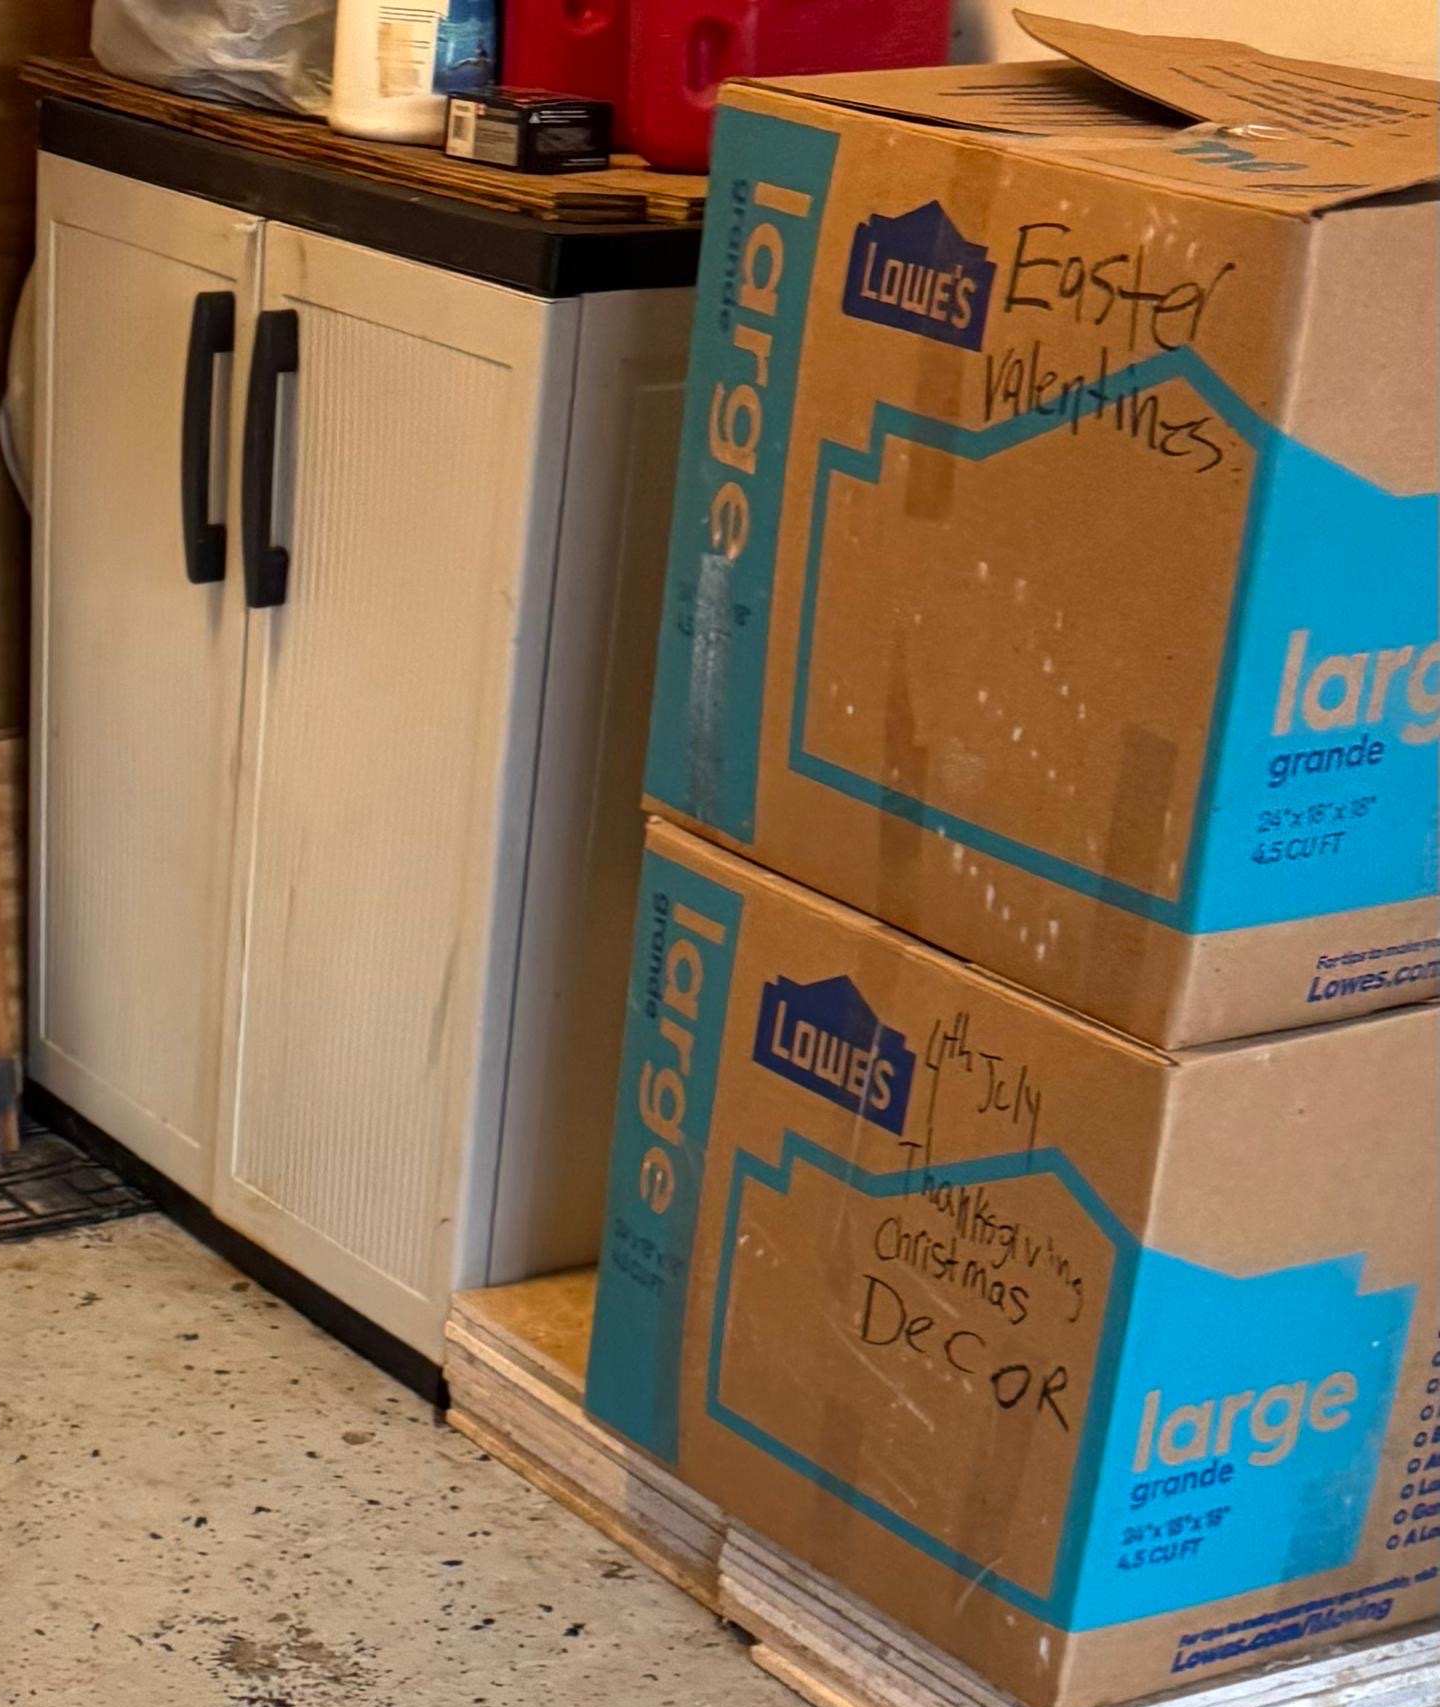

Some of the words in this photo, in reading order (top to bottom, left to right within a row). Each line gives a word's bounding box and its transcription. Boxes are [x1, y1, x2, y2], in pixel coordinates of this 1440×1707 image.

[860, 242, 977, 330] LOWE'S
[1004, 222, 1236, 352] Easter
[708, 181, 813, 561] large
[1268, 734, 1385, 788] grande
[638, 902, 728, 1216] large
[771, 1001, 896, 1111] LOWE'S
[875, 1216, 1030, 1325] Christmas
[1131, 1371, 1358, 1473] large
[1129, 1460, 1236, 1511] grande
